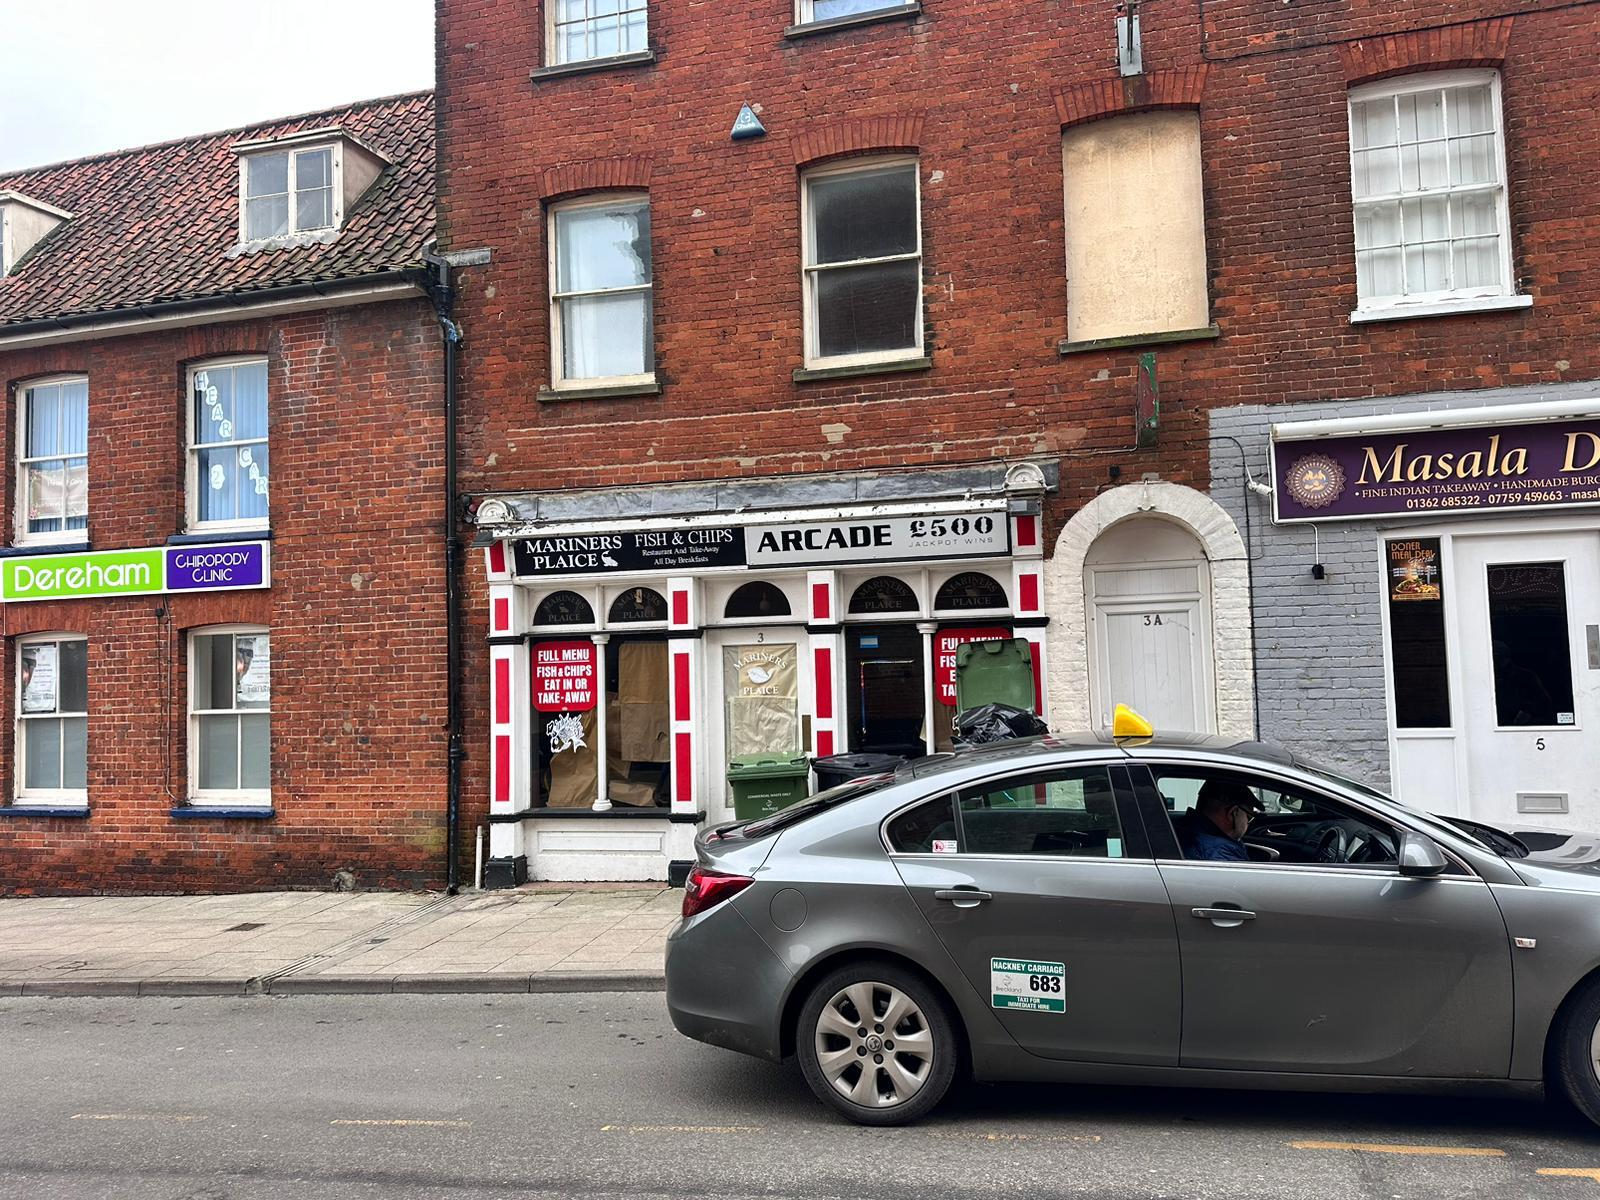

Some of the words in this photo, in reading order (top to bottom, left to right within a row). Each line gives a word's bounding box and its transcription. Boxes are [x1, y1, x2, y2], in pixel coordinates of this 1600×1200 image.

[196, 373, 231, 437] HEAR
[1354, 434, 1528, 485] Masala
[1362, 488, 1388, 498] FINE
[1389, 485, 1431, 496] INDIAN
[1432, 481, 1492, 494] TAKEAWAY
[1501, 477, 1569, 490] HANDMADE
[1406, 497, 1439, 509] 01362
[1441, 495, 1480, 507] 685322
[1488, 492, 1522, 504] 07759
[1523, 490, 1563, 502] 459663
[634, 532, 668, 548] FISH
[671, 531, 685, 546] &
[687, 528, 734, 545] CHIPS
[757, 524, 893, 553] ARCADE
[909, 516, 994, 538] £500
[525, 535, 623, 554] MARINERS
[908, 538, 958, 549] JACKPOT
[964, 536, 994, 545] WINS
[1391, 541, 1421, 551] DONER
[642, 549, 673, 557] Restaurant
[674, 546, 687, 555] And
[1391, 550, 1412, 560] MEAL
[175, 551, 250, 569] CHIROPODY
[533, 553, 599, 570] PLAICE
[653, 558, 664, 566] All
[664, 557, 676, 566] Day
[677, 555, 709, 564] Breakfasts
[14, 561, 151, 593] Dereham
[192, 568, 233, 583] CLINIC
[865, 600, 902, 609] PLAICE
[952, 597, 991, 606] PLAICE
[548, 613, 581, 622] PLAICE
[1143, 614, 1163, 626] 3A
[757, 632, 764, 643] 3
[538, 649, 559, 661] FULL
[562, 648, 590, 660] MENU
[733, 651, 788, 671] MARINERS
[544, 679, 561, 691] EAT
[563, 678, 573, 690] IN
[574, 678, 588, 690] OR
[743, 686, 779, 695] PLAICE
[1536, 737, 1546, 751] 5
[993, 961, 1026, 972] HACKNEY
[1027, 964, 1064, 974] CARRIAGE
[1029, 974, 1061, 993] 683
[1007, 1001, 1037, 1010] IMMEDIATE
[1037, 1003, 1050, 1011] HIRE
[1029, 996, 1041, 1004] FOR
